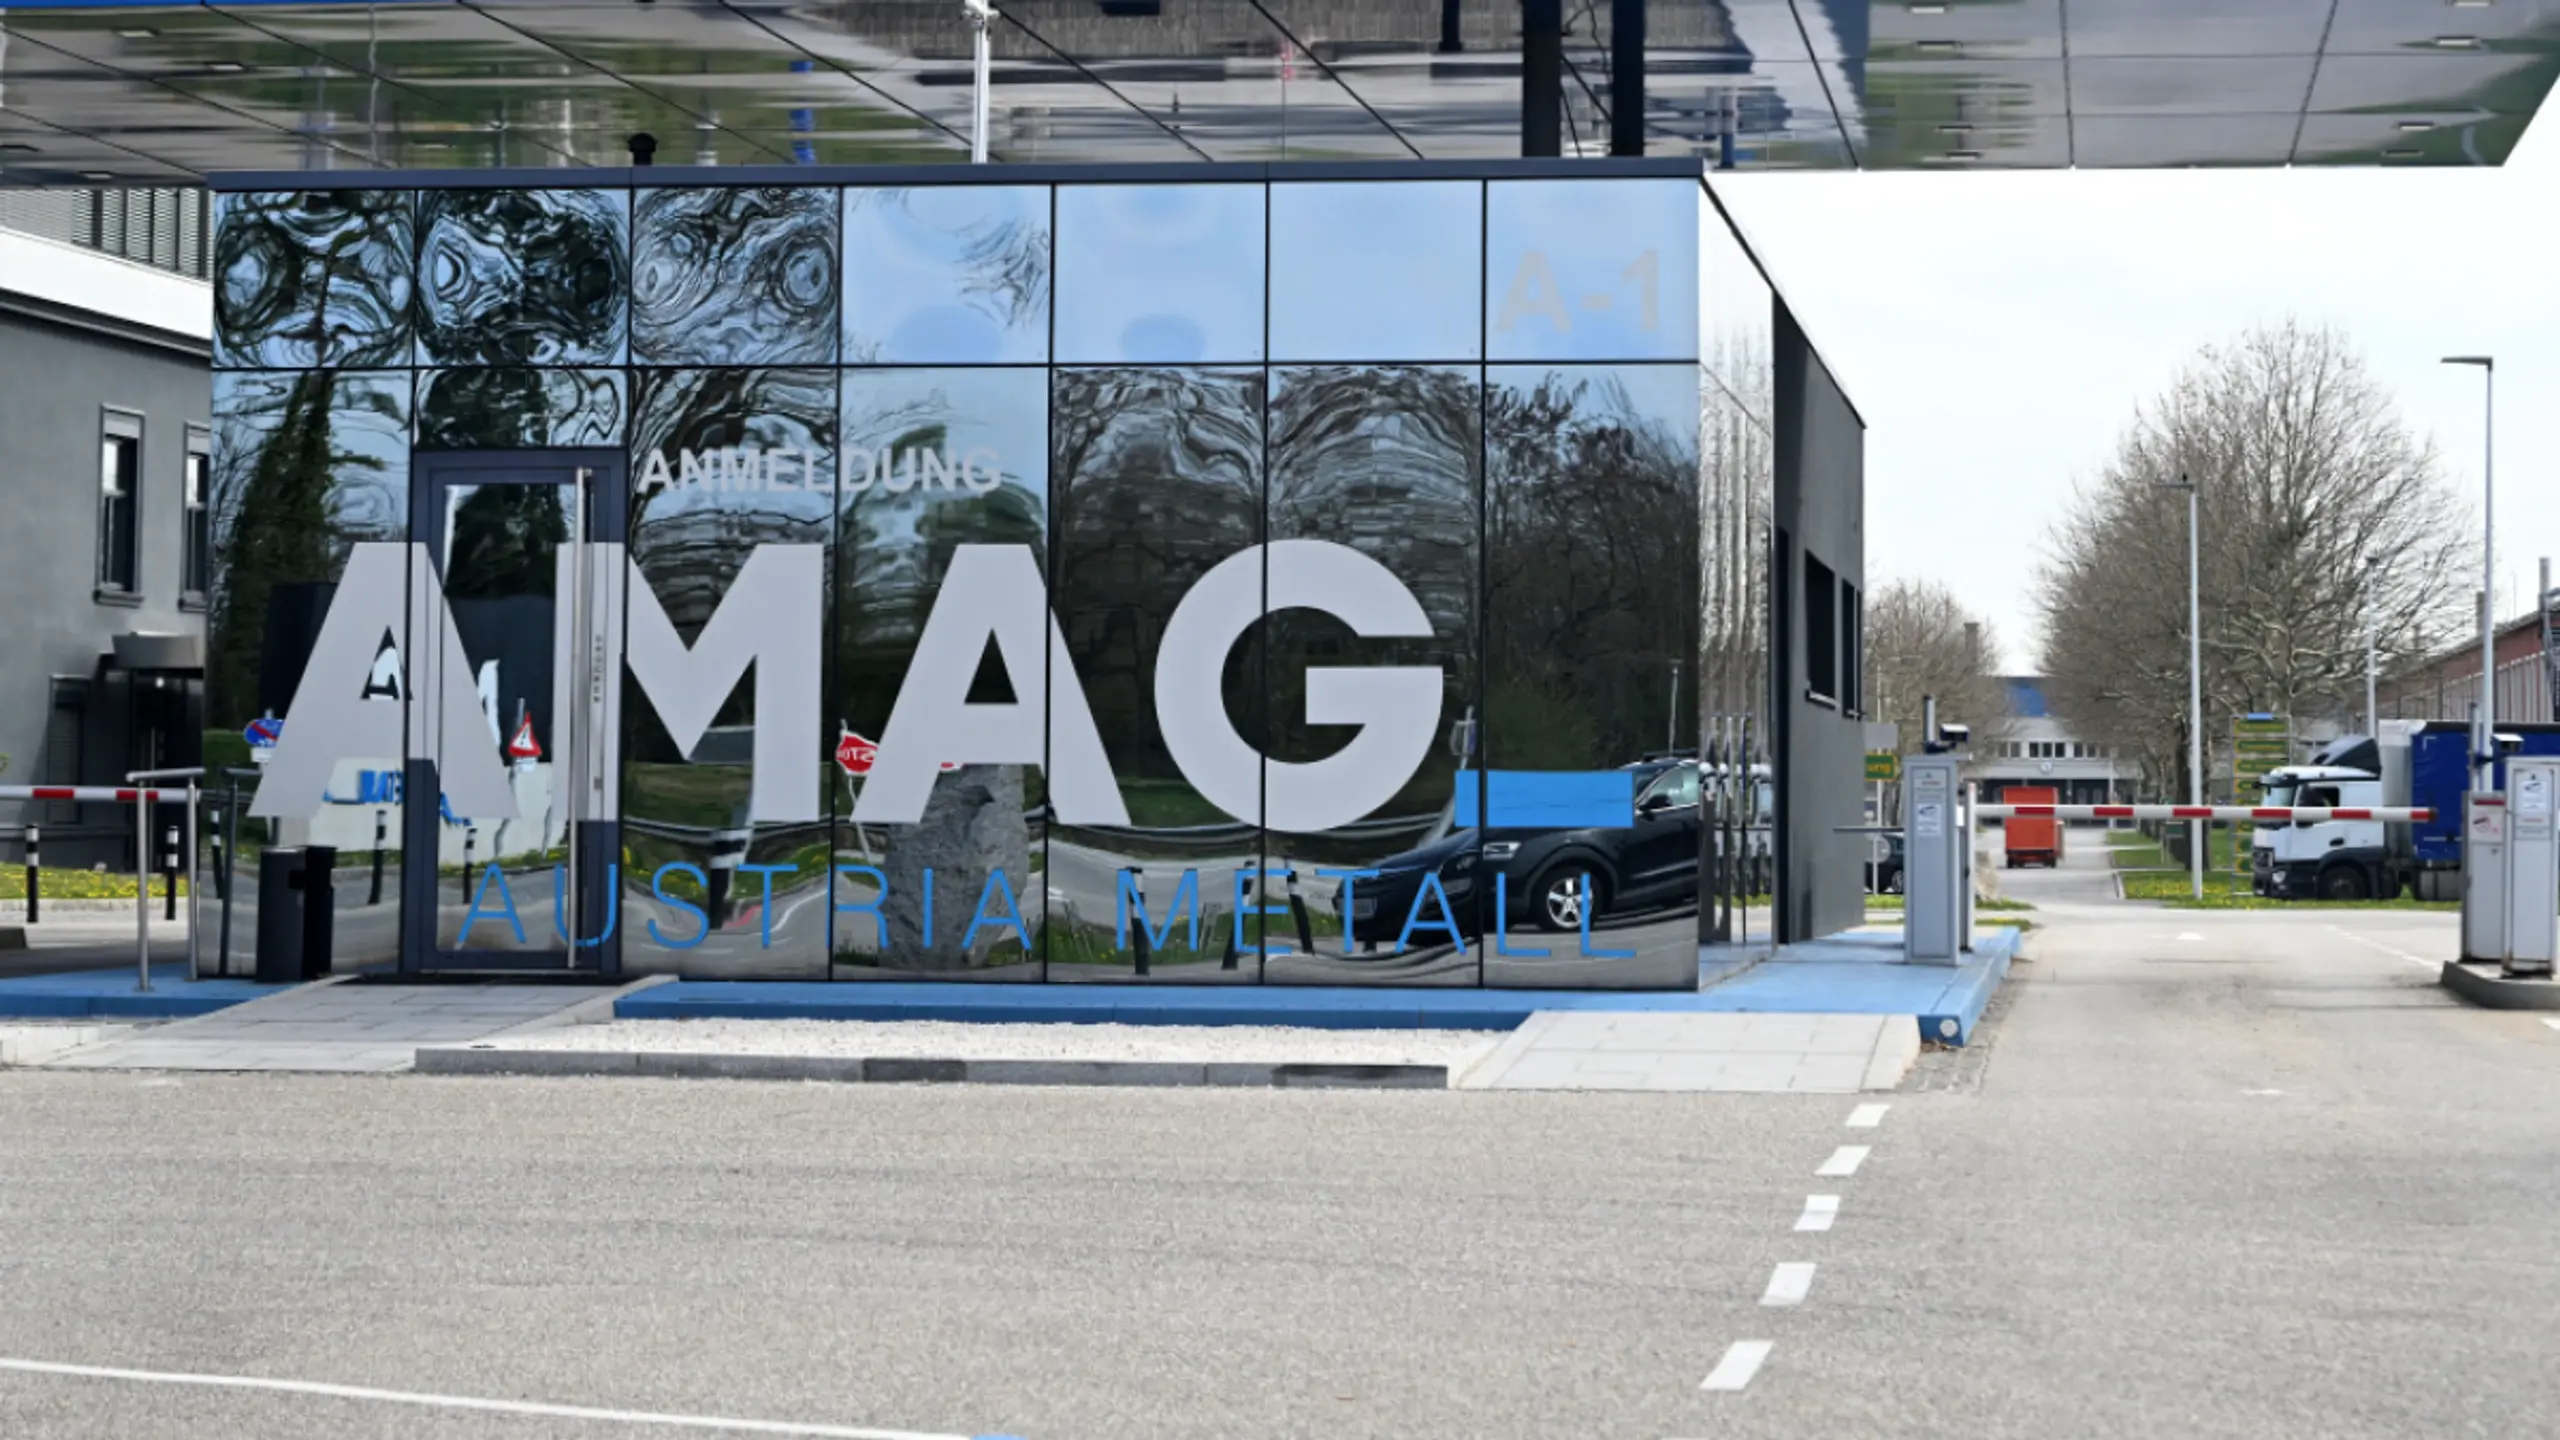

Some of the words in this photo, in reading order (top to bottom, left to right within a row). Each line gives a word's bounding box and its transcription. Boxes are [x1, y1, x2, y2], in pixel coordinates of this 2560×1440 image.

[1495, 249, 1660, 334] A-1
[636, 446, 1001, 494] ANMELDUNG
[249, 538, 1445, 833] AMAG
[455, 861, 1034, 951] AUSTRIA
[1115, 867, 1637, 958] METALL
